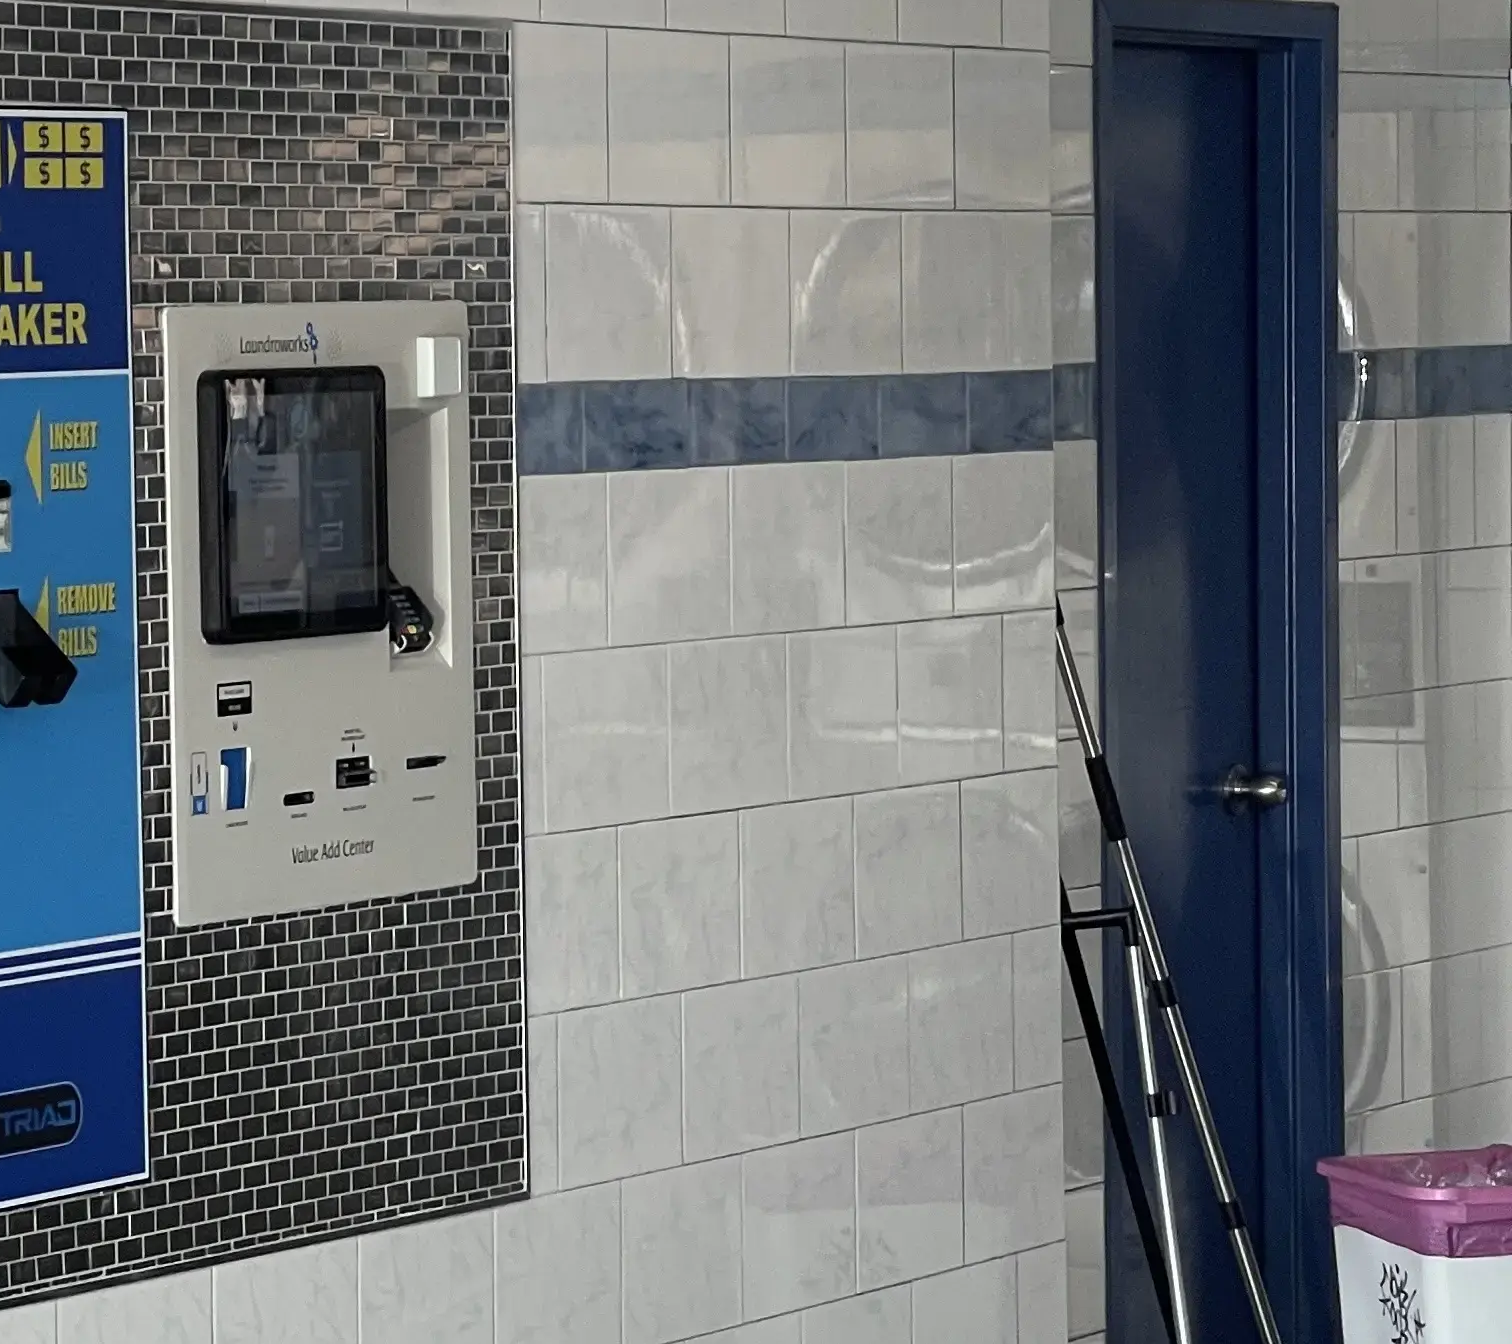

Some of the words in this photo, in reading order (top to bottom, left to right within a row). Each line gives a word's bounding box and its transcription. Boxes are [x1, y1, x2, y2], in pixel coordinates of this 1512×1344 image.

[240, 334, 309, 354] Laundroworks
[49, 421, 98, 450] INSERT
[50, 461, 88, 490] BILLS
[57, 582, 116, 615] REMOVE
[58, 625, 98, 657] BILLS
[292, 845, 319, 864] Value
[321, 841, 341, 859] Add
[342, 838, 375, 857] Center
[0, 1099, 76, 1137] TRIAD
